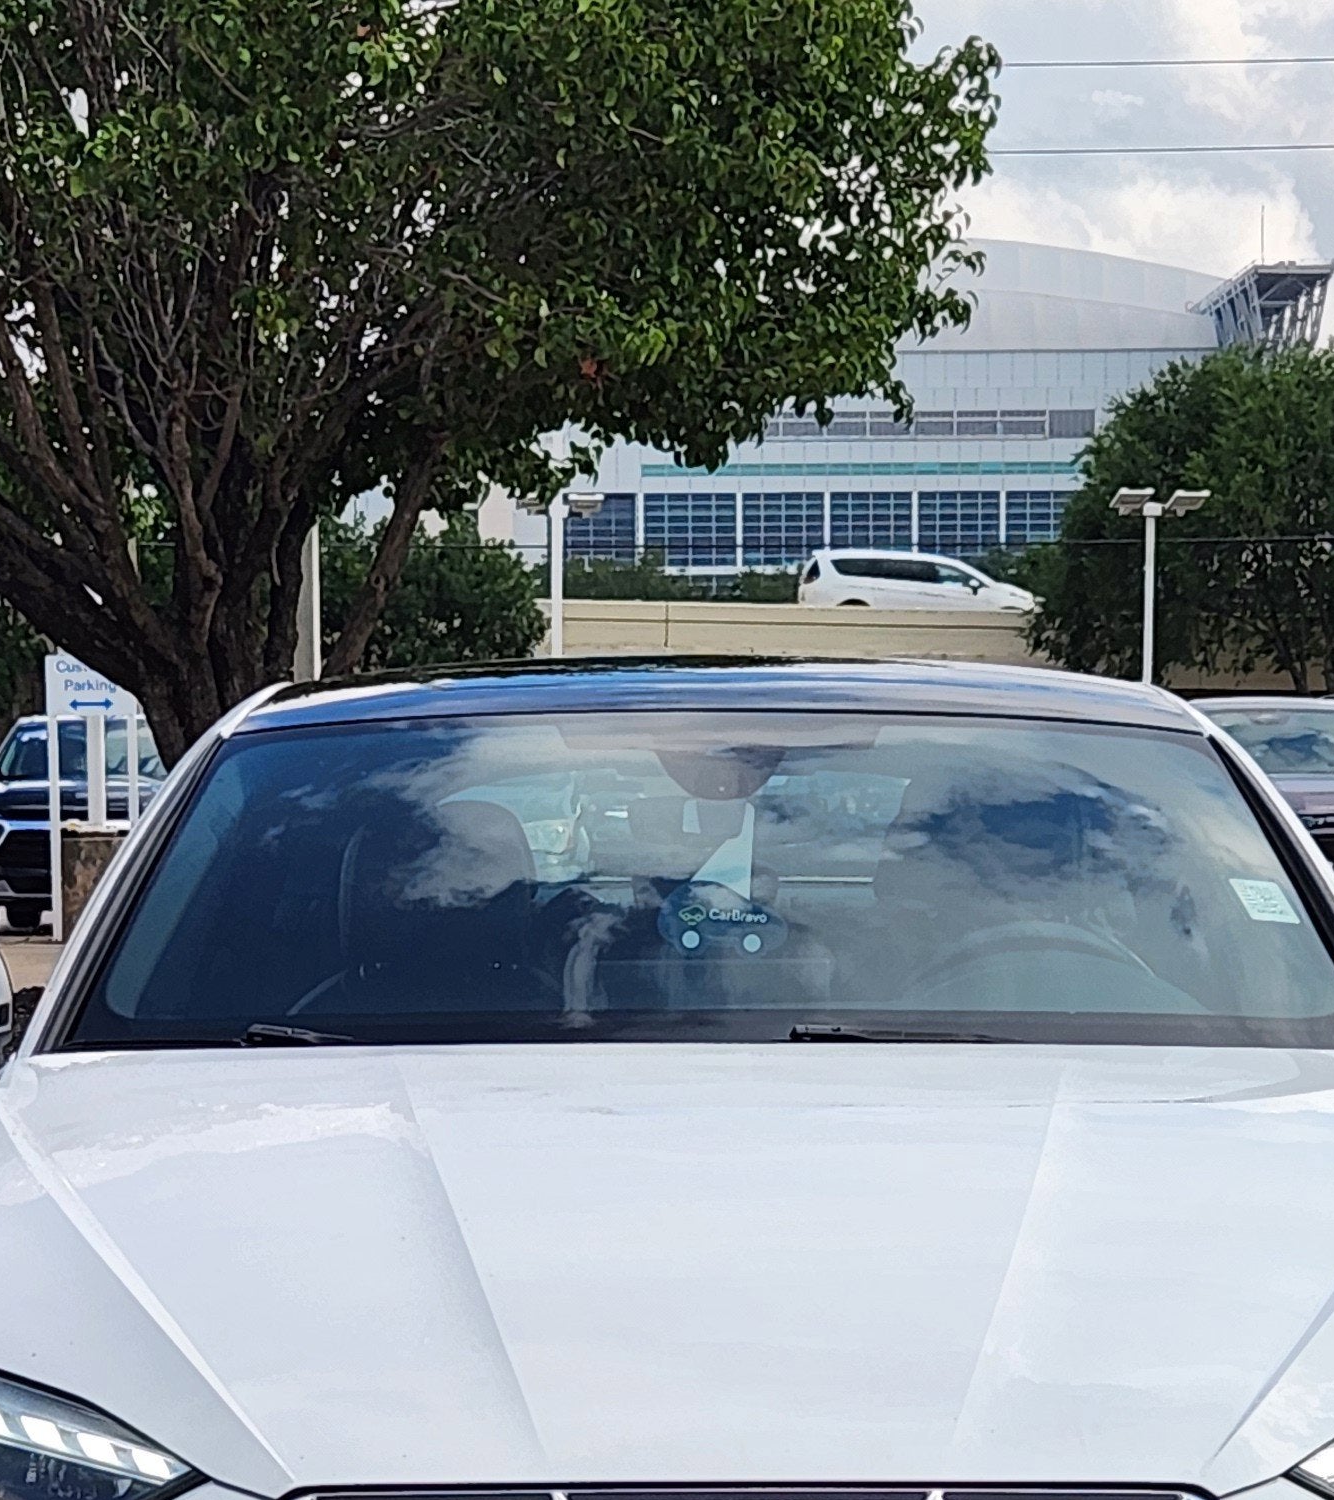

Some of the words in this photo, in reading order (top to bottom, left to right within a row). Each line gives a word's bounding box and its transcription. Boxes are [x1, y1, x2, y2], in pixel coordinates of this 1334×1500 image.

[55, 659, 88, 674] Cus
[63, 679, 117, 694] Parking
[708, 907, 768, 924] CarBravo
